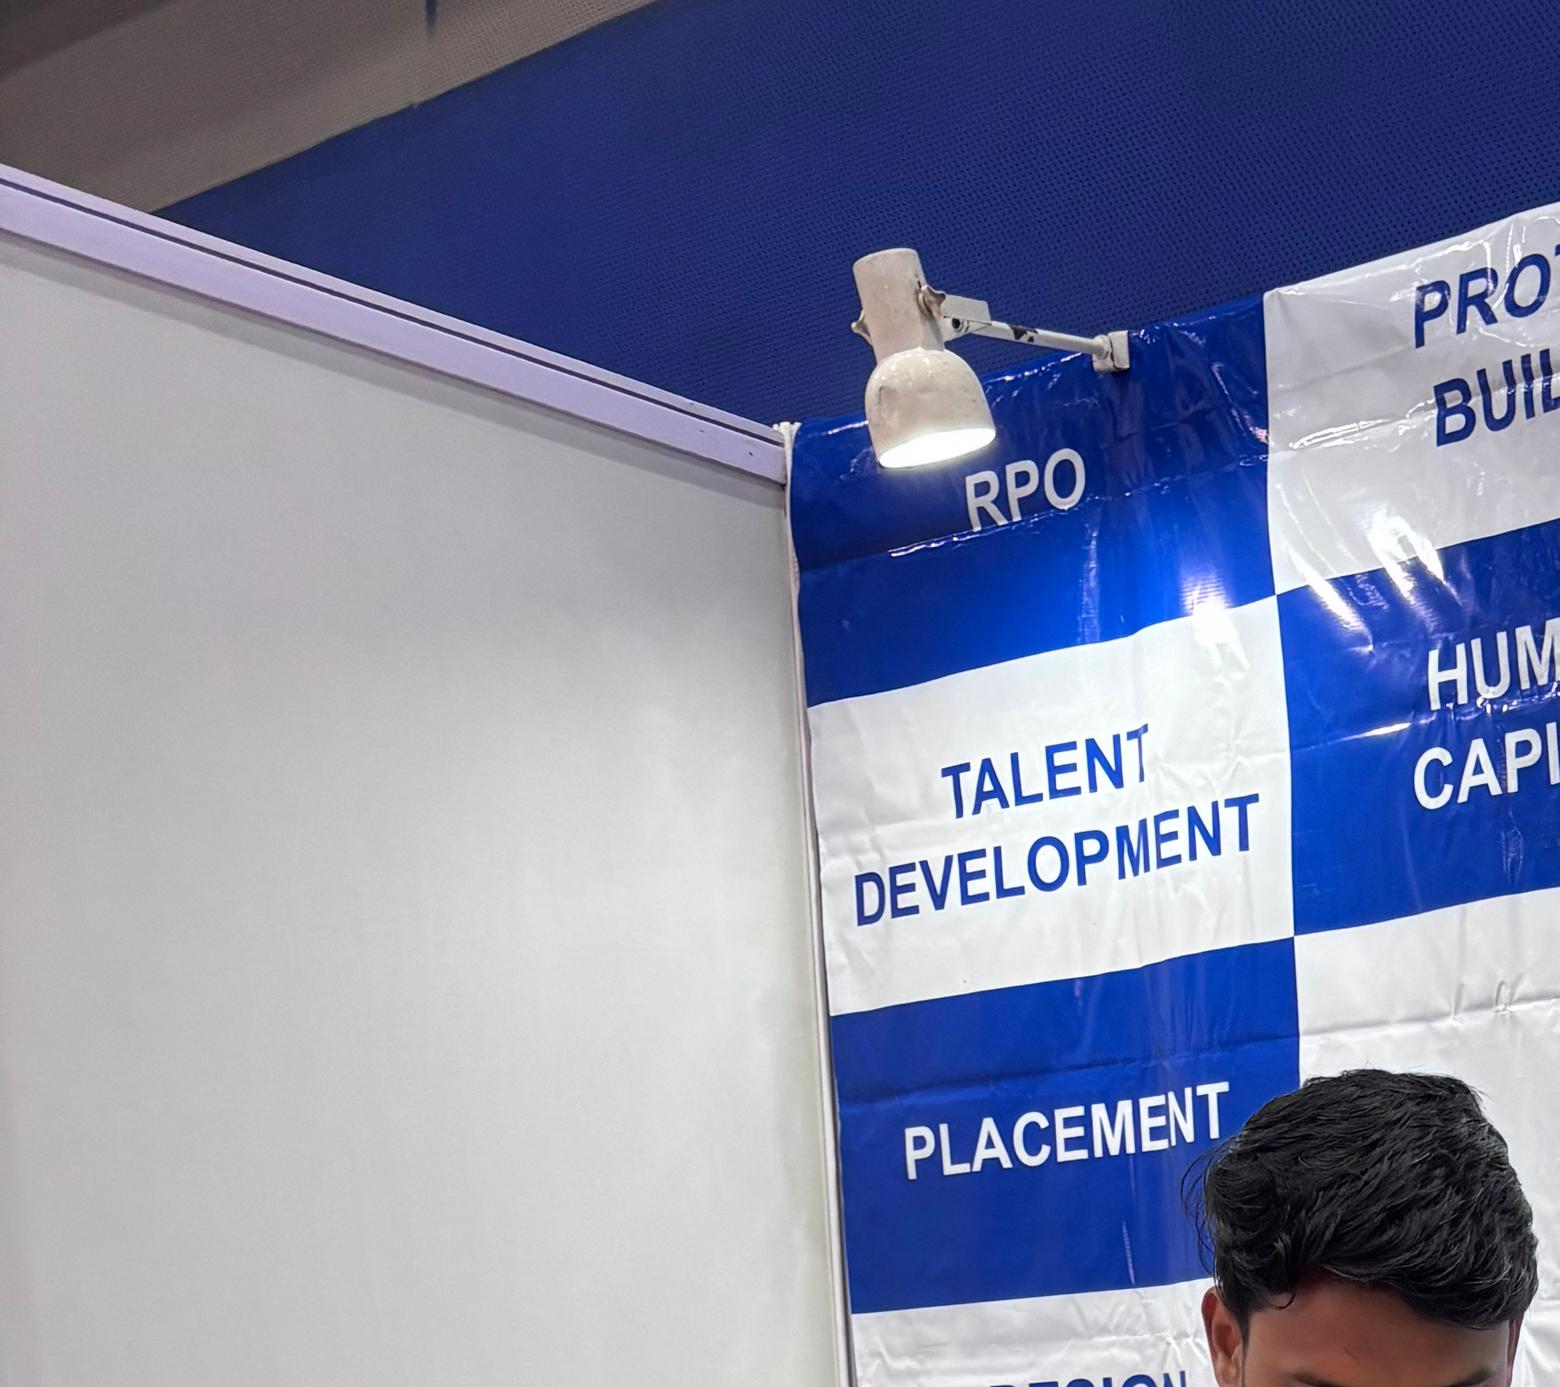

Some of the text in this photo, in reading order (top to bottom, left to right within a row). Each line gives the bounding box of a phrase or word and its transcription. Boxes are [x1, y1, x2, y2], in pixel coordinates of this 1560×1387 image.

[965, 447, 1087, 531] RPO
[940, 723, 1150, 822] TALENT
[854, 793, 1262, 927] DEVELOPMENT
[903, 1081, 1231, 1181] PLACEMENT
